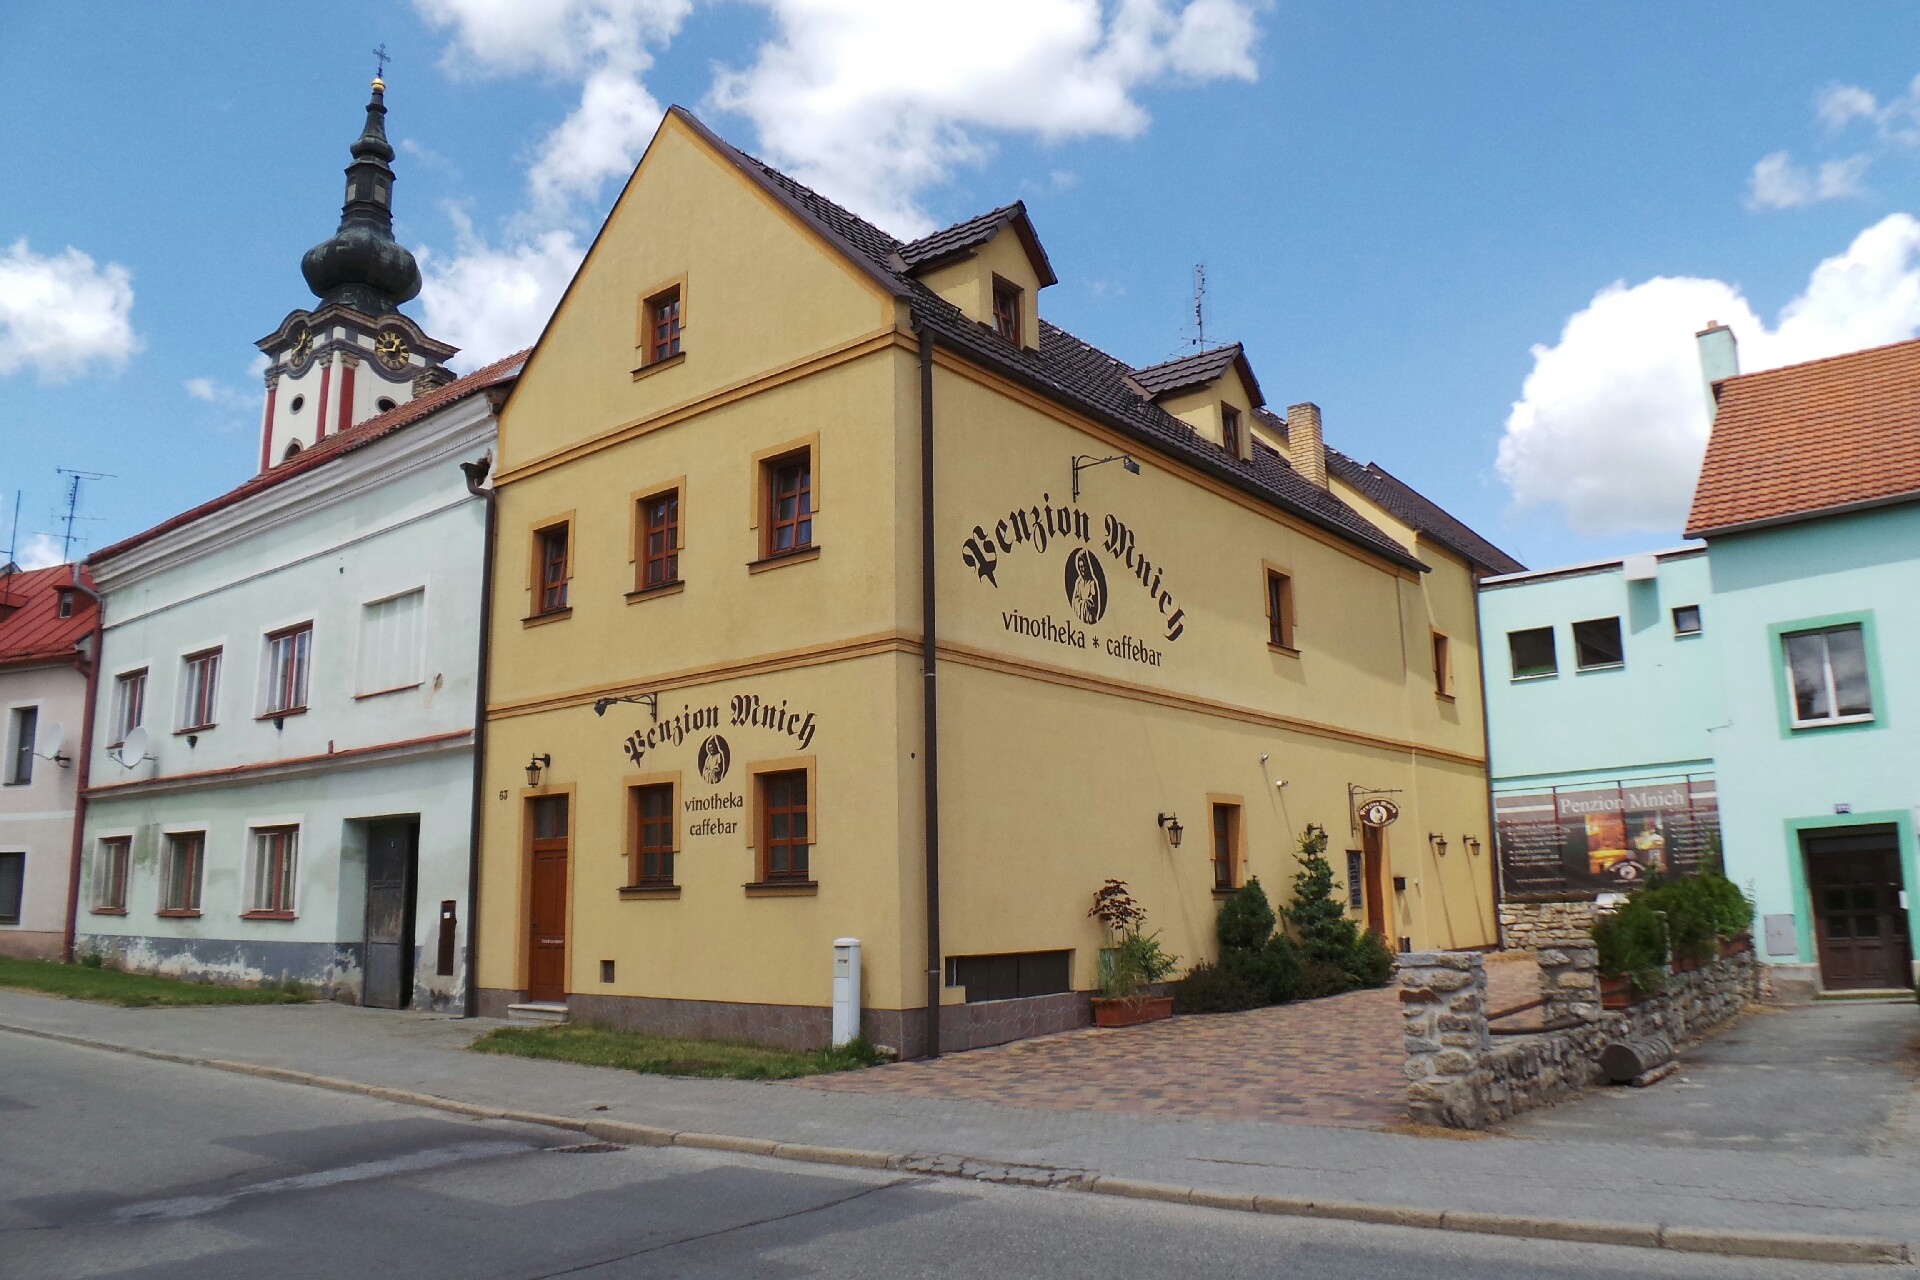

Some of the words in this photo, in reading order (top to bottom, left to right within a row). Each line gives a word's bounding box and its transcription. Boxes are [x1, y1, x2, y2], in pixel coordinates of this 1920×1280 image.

[962, 493, 1091, 588] Penzion
[1102, 514, 1186, 642] Mnich
[1002, 609, 1086, 648] vinotheka
[1106, 635, 1162, 667] caffebar
[624, 704, 719, 768] Penzion
[730, 694, 817, 750] Mnich
[685, 792, 744, 812] vinotheka
[1561, 796, 1624, 813] Penzion
[1629, 790, 1685, 809] Mnich
[689, 818, 737, 836] caffebar
